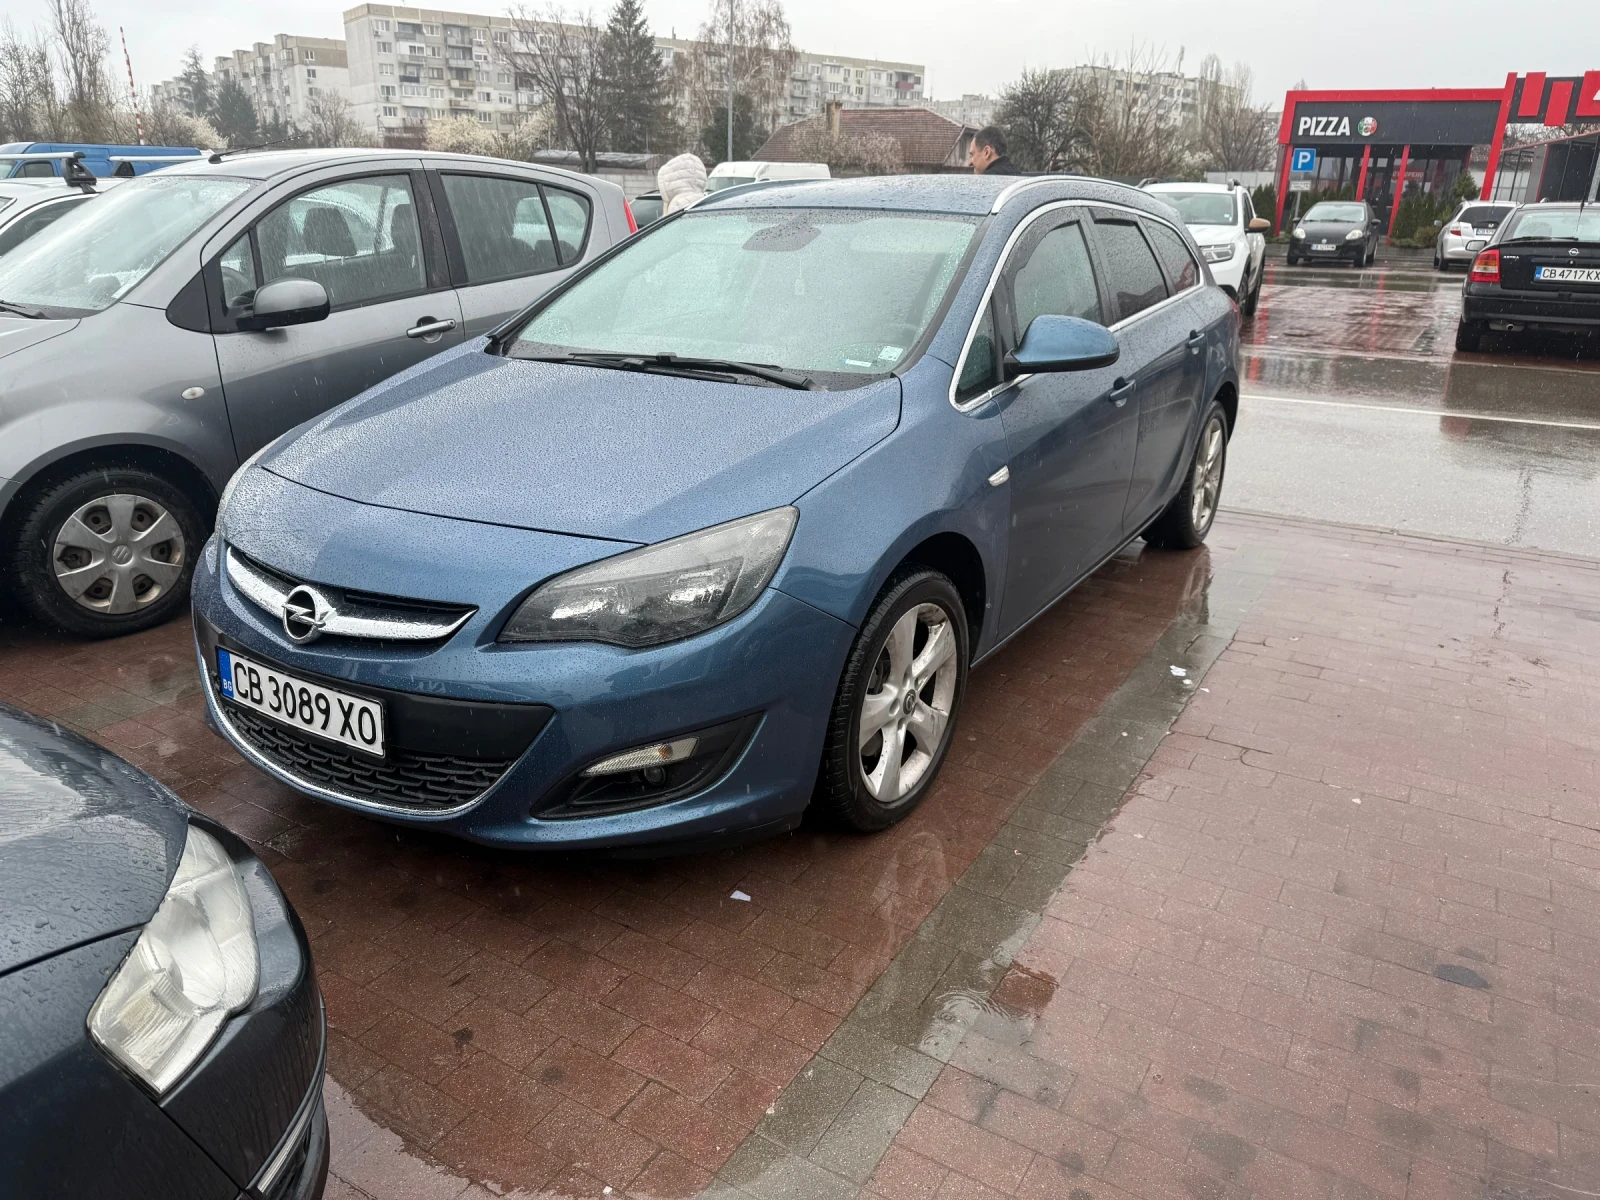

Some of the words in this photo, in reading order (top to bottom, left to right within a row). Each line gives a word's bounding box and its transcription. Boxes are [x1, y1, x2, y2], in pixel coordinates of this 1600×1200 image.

[1298, 116, 1351, 136] PIZZA
[1297, 151, 1311, 169] P
[1542, 268, 1557, 279] CB
[1558, 269, 1586, 280] 4717
[223, 678, 233, 692] BG
[233, 661, 264, 705] CB
[268, 675, 331, 731] 3089
[337, 697, 377, 745] XO
